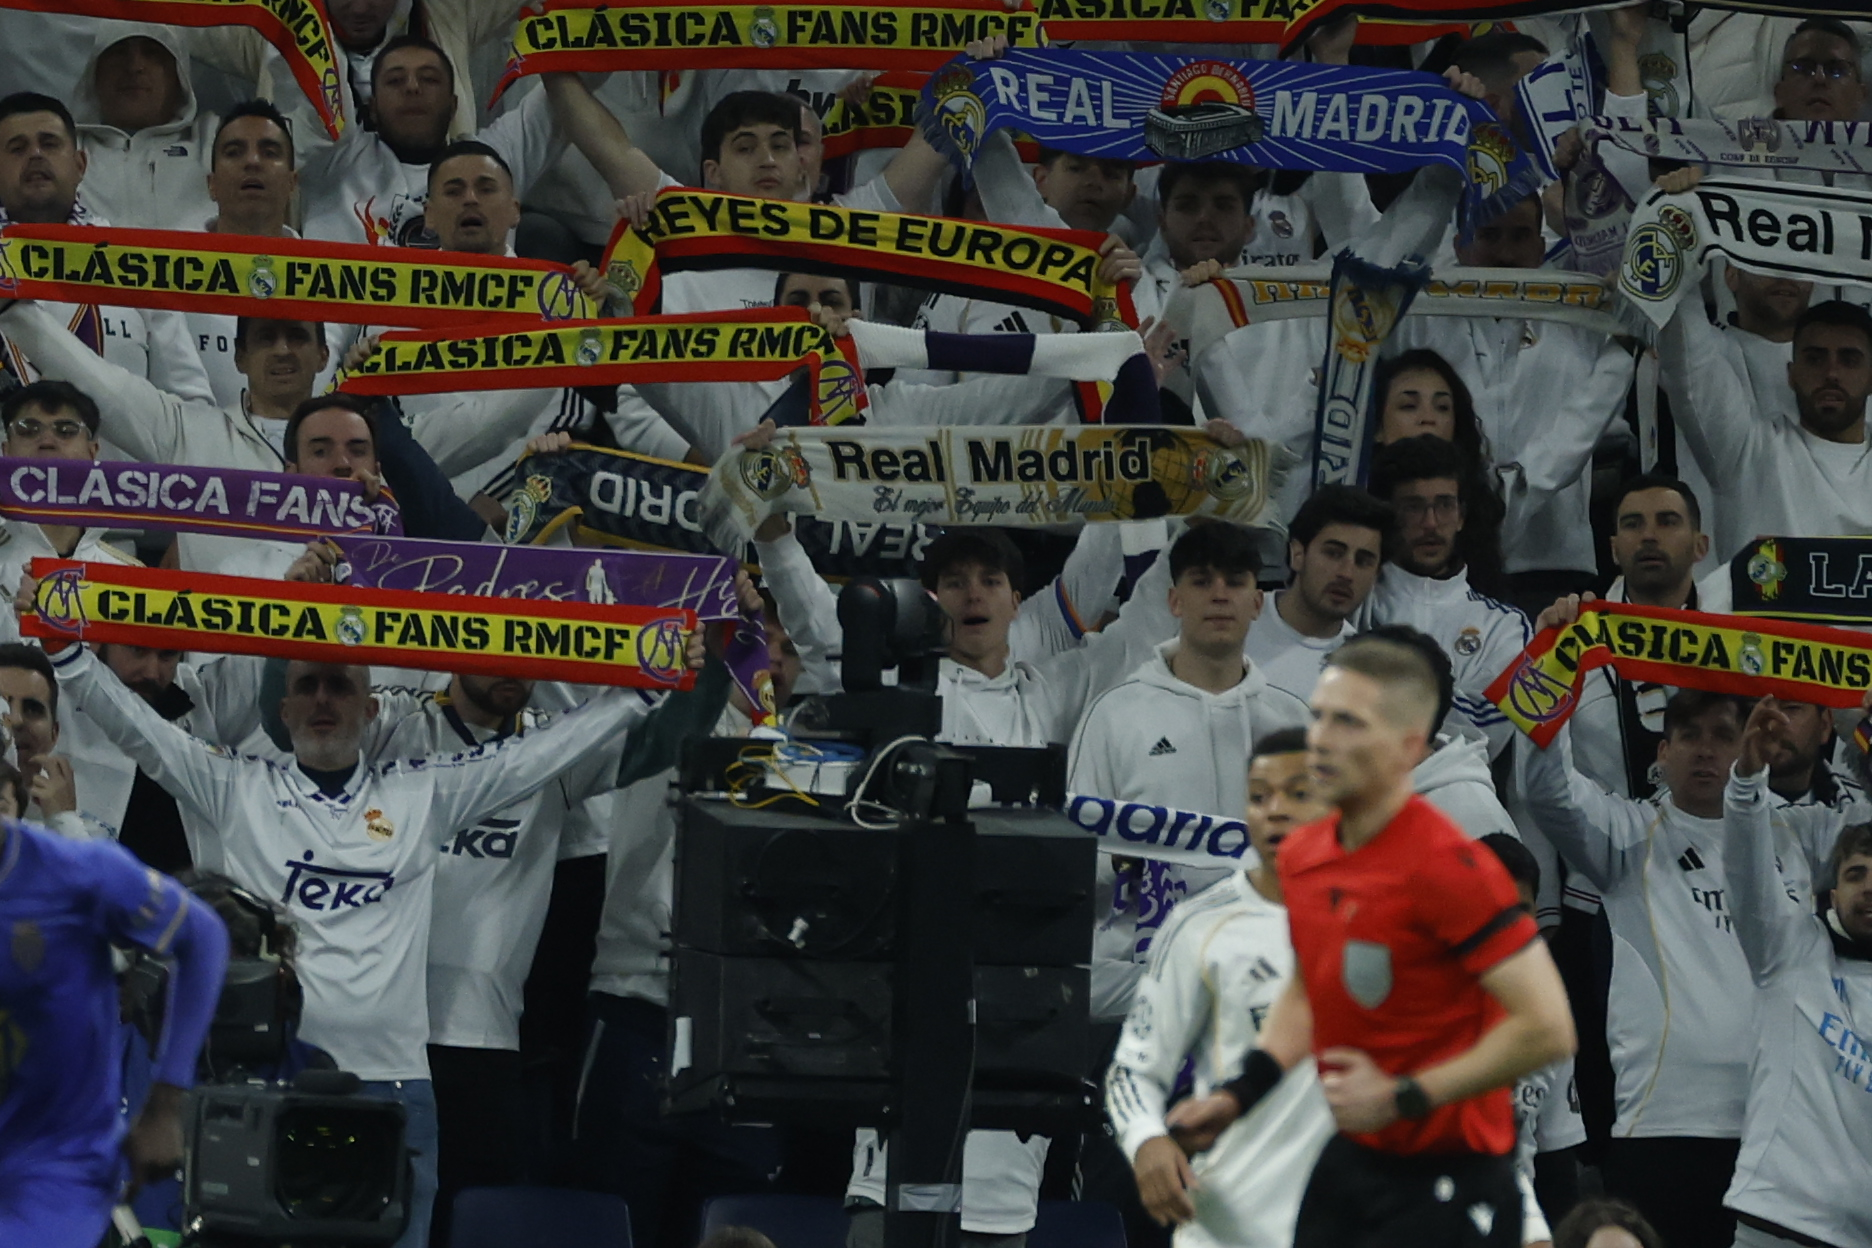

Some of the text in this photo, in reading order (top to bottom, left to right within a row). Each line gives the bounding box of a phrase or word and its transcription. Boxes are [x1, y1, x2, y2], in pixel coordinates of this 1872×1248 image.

[526, 4, 1034, 51] CLÁSICA FANS RMCF
[991, 66, 1471, 144] REAL MADRID
[638, 190, 1097, 293] REYES DE EUROPA
[1701, 192, 1834, 255] Real
[19, 240, 533, 310] CLÁSICA FANS RMCF
[610, 327, 717, 361] FANS
[831, 439, 1150, 484] Real Madrid
[9, 460, 231, 516] CLÁSICA
[245, 479, 376, 530] FANS
[589, 470, 702, 533] DRID
[1015, 488, 1040, 515] del
[97, 589, 631, 661] CLÁSICA FANS RMCF
[1771, 641, 1872, 690] FANS
[284, 850, 394, 912] Teka
